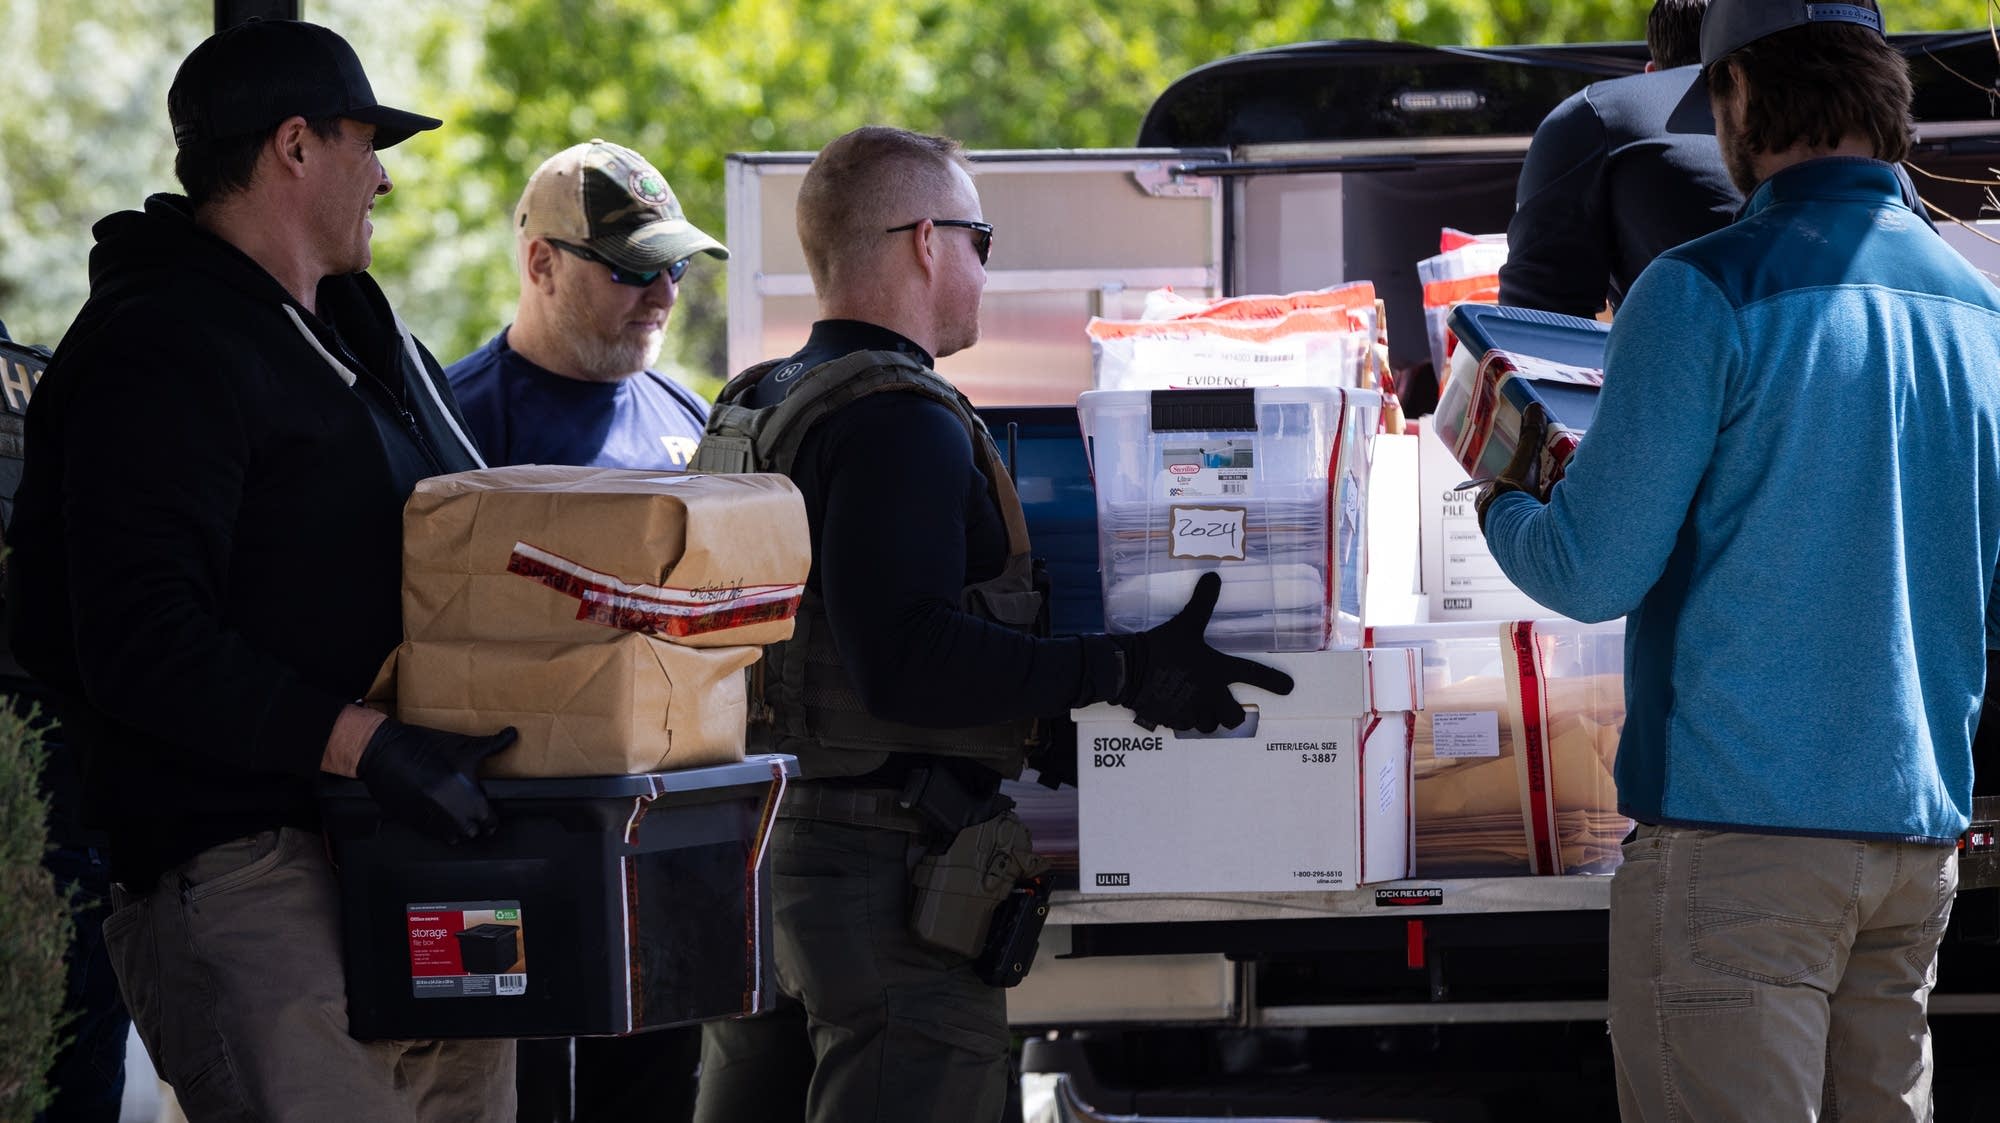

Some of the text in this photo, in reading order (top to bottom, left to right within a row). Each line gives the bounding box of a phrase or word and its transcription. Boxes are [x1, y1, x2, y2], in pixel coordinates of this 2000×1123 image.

[0, 357, 43, 409] H
[1186, 375, 1249, 387] EVIDENCE
[1443, 505, 1464, 516] FILE
[1179, 519, 1236, 549] 2024
[1093, 737, 1163, 751] STORAGE
[1266, 742, 1338, 751] LETTER/LEGAL SIZE
[1094, 753, 1126, 767] BOX
[1302, 753, 1337, 763] S-3887
[1293, 870, 1343, 878] 1-800-295-5510
[1097, 875, 1129, 885] ULINE
[1376, 889, 1442, 898] LOCK RELEASE
[411, 929, 447, 940] storage
